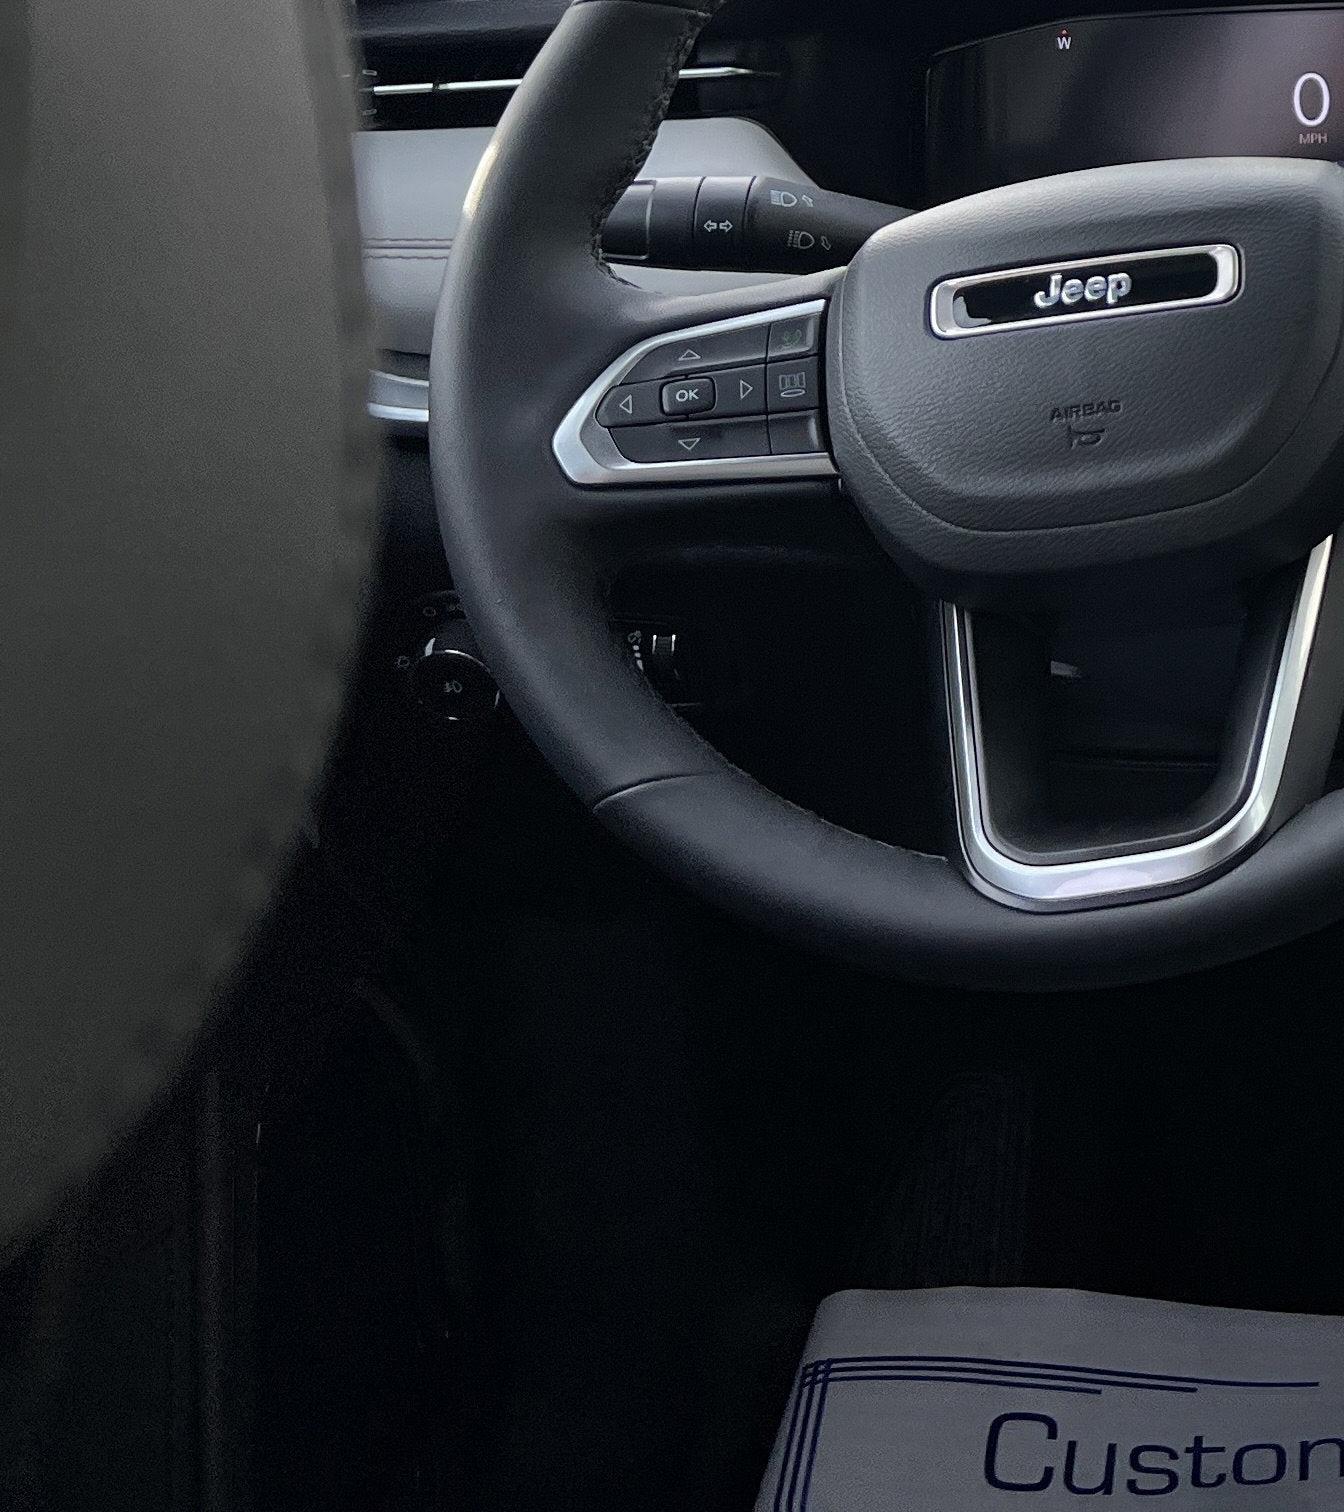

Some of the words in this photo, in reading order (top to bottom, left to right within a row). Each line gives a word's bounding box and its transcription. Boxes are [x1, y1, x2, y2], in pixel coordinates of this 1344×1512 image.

[1057, 35, 1072, 50] W
[1293, 71, 1330, 127] 0
[1299, 132, 1328, 145] MPH
[1033, 272, 1132, 310] Jeep
[675, 388, 700, 402] OK
[1050, 399, 1122, 424] AIRBAG
